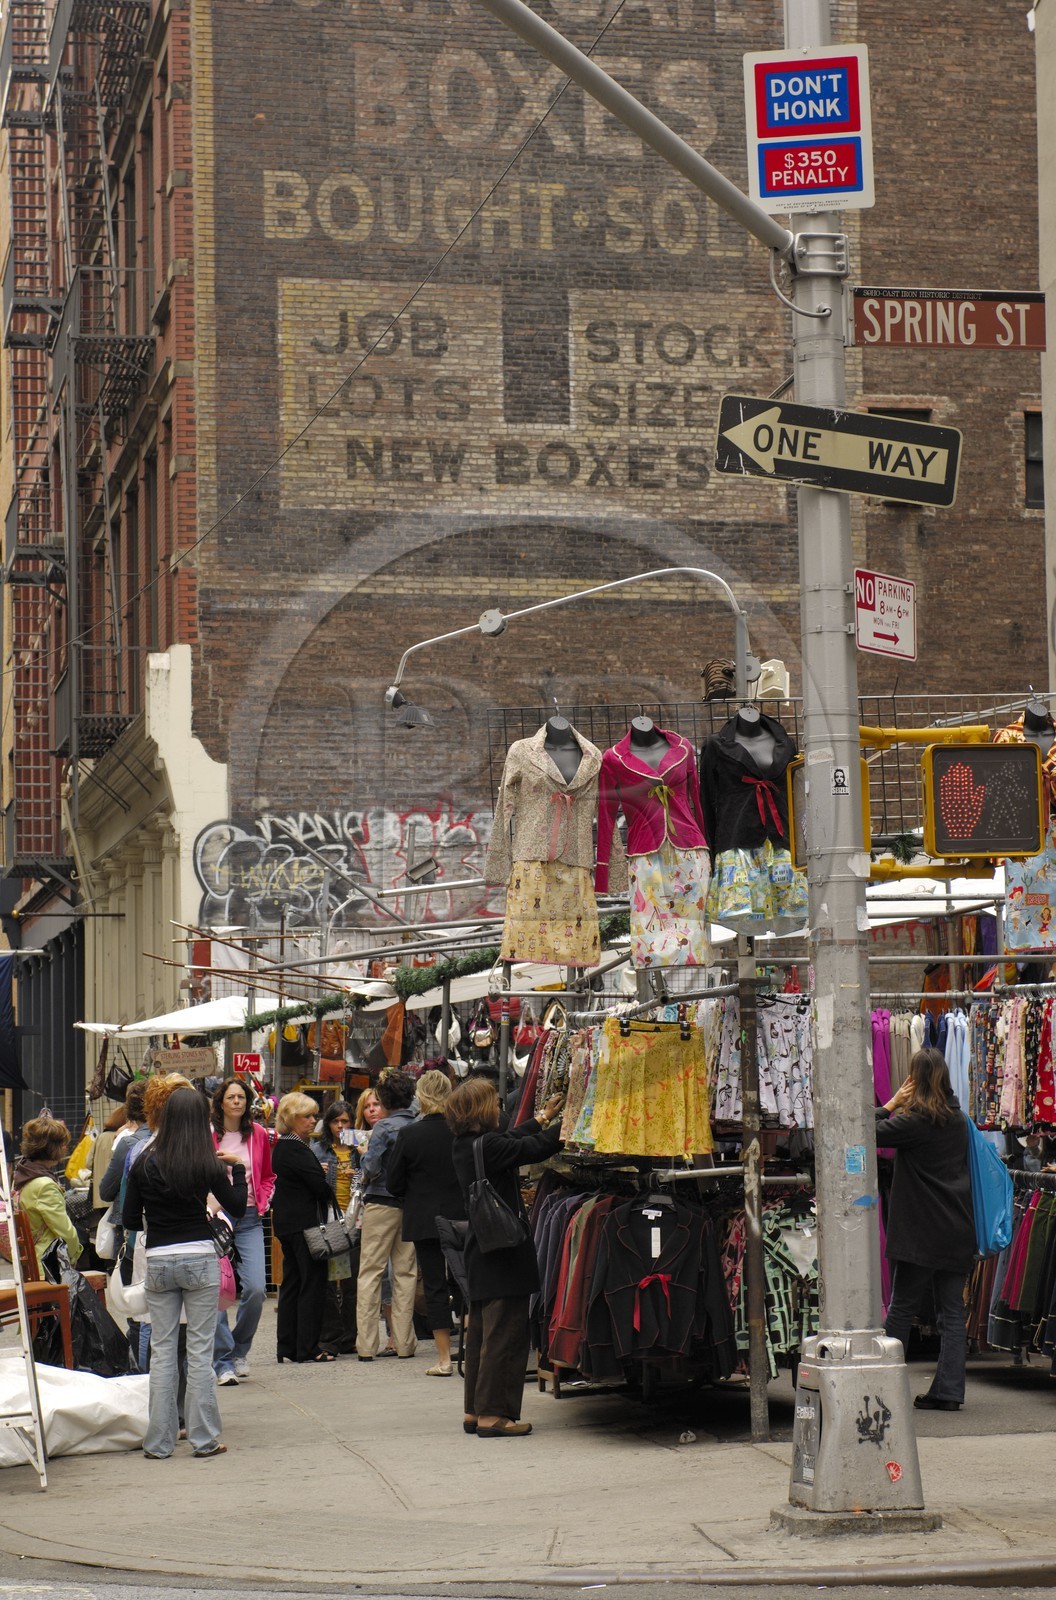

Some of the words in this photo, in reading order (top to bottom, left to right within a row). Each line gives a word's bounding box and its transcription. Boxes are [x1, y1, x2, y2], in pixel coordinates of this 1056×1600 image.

[353, 44, 718, 158] BOXES
[770, 74, 842, 97] DON'T
[773, 98, 842, 121] HONK
[772, 166, 849, 187] PENALTY
[784, 150, 837, 169] $350
[262, 169, 566, 250] BOUGHT
[605, 186, 770, 257] SOL
[901, 290, 918, 298] IRON
[919, 291, 951, 299] HISTORIC
[952, 292, 983, 300] DISTRICT
[310, 310, 449, 358] JOB
[585, 321, 772, 369] STOCK
[862, 299, 977, 346] SPRING
[995, 302, 1031, 346] ST
[308, 373, 471, 422] LOTS
[587, 382, 757, 427] SIZE
[345, 436, 469, 483] NEW
[495, 441, 711, 490] BOXES
[753, 423, 822, 462] ONE
[868, 440, 939, 478] WAY
[856, 576, 874, 605] NO
[878, 581, 911, 602] PARKING
